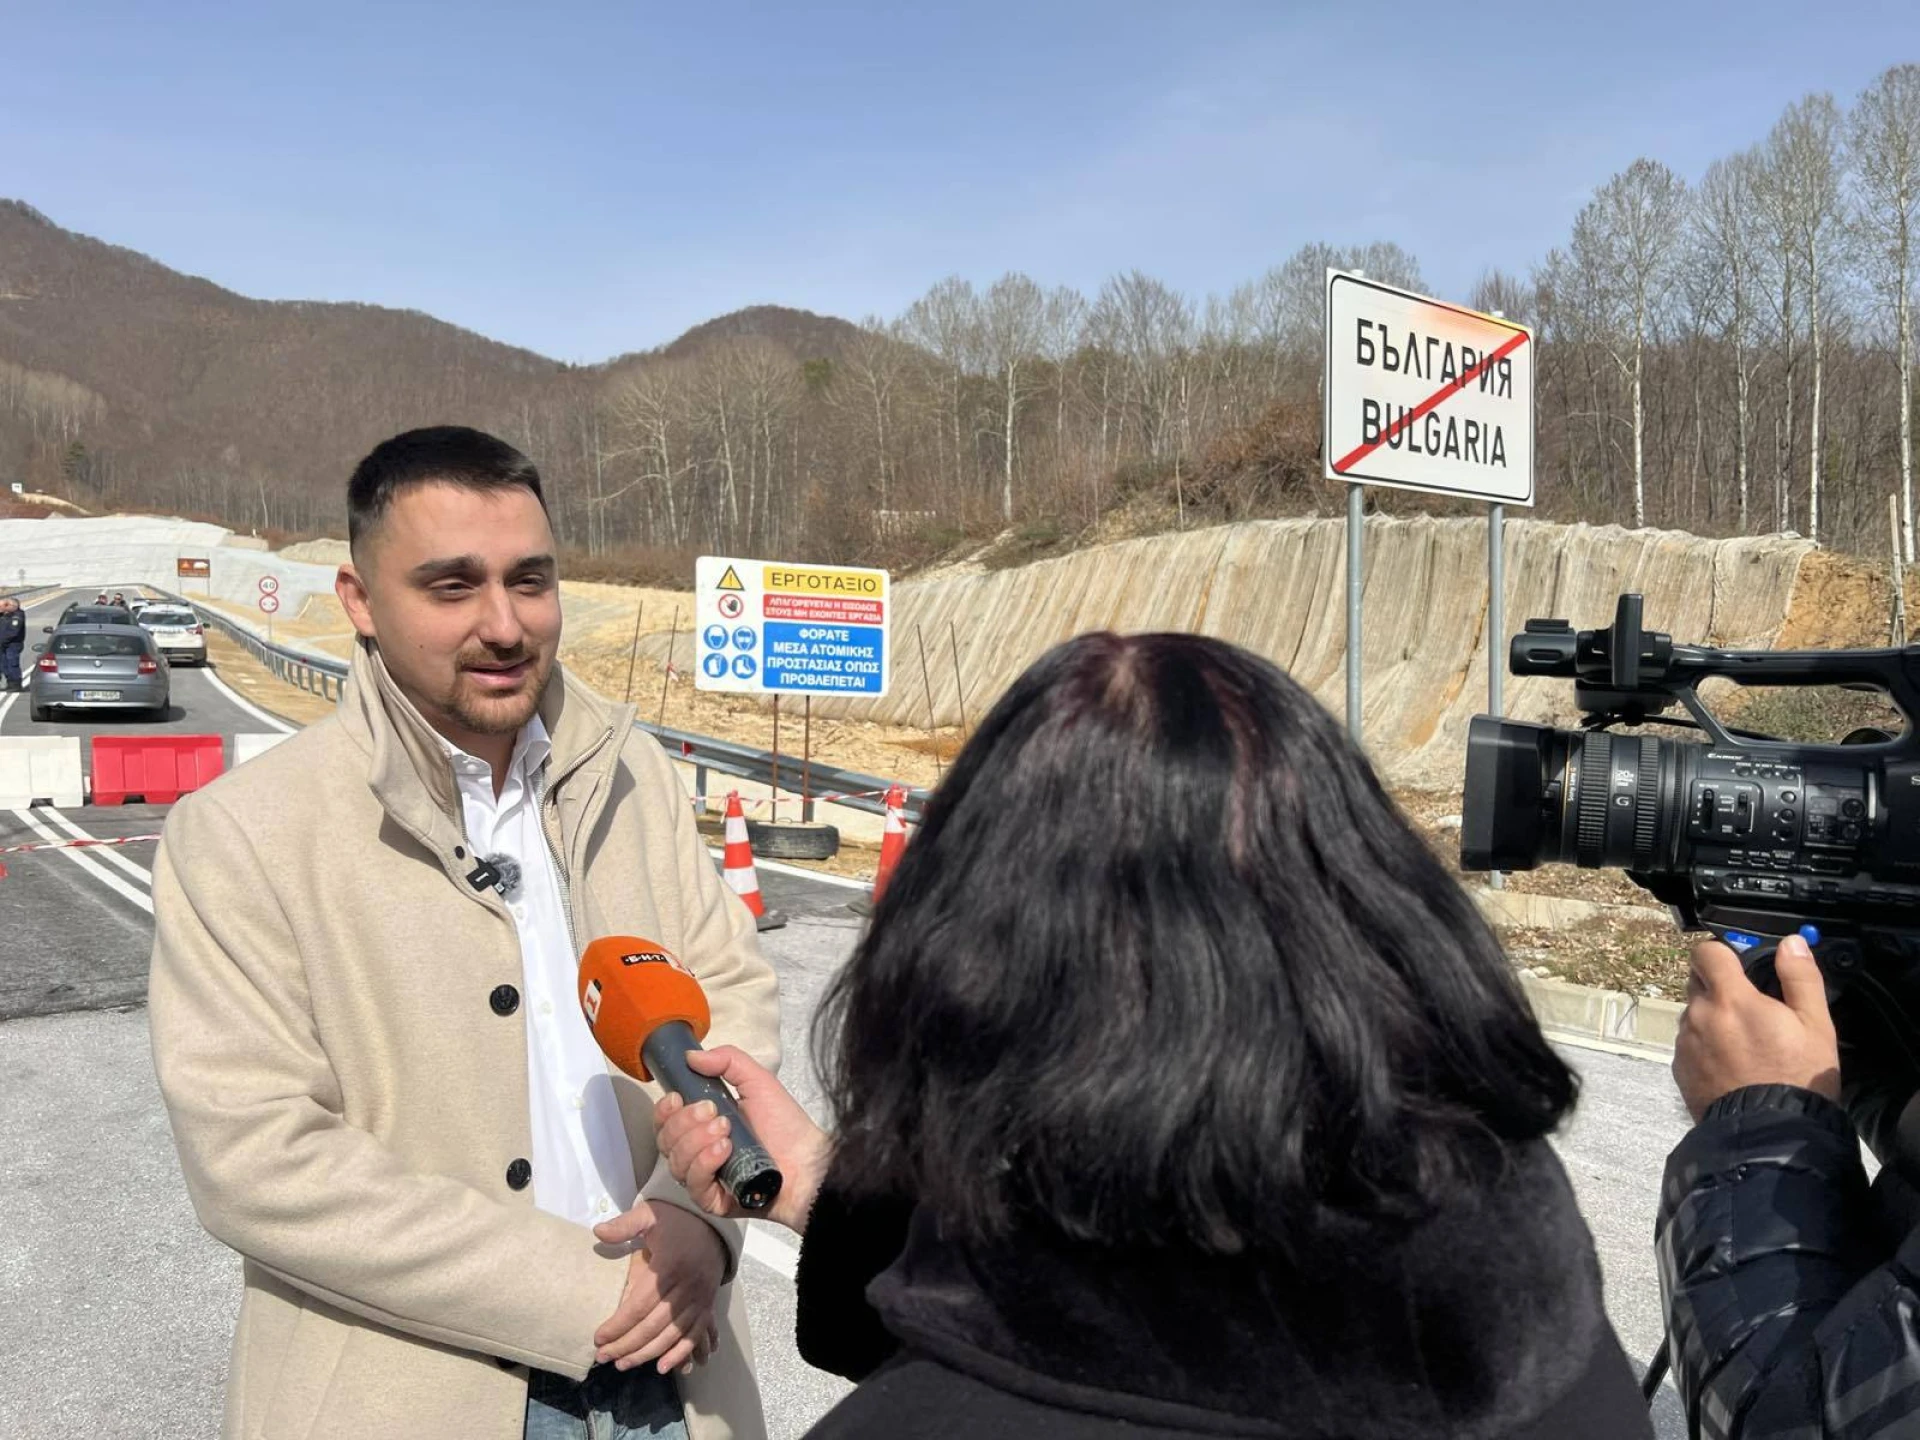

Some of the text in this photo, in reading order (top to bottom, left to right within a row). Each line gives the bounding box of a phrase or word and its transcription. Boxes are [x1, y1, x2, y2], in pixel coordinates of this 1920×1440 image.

[1356, 317, 1512, 399] БЪЛГАРИЯ
[1362, 398, 1507, 468] BULGARIA
[771, 572, 876, 592] ΕΡΓΟΤΑΞΙΟ
[798, 628, 850, 642] ΦΟΡΑΤΕ
[773, 641, 875, 658] ΜΕΣΑ ΑΤΟΜΙΚΗΣ
[767, 656, 880, 673] ΠΡΟΣΤΑΣΙΑΣ ΟΠΩΣ
[780, 672, 866, 688] ΠΡΟΒΛΕΠΕΤΑΙ
[1615, 796, 1630, 807] G
